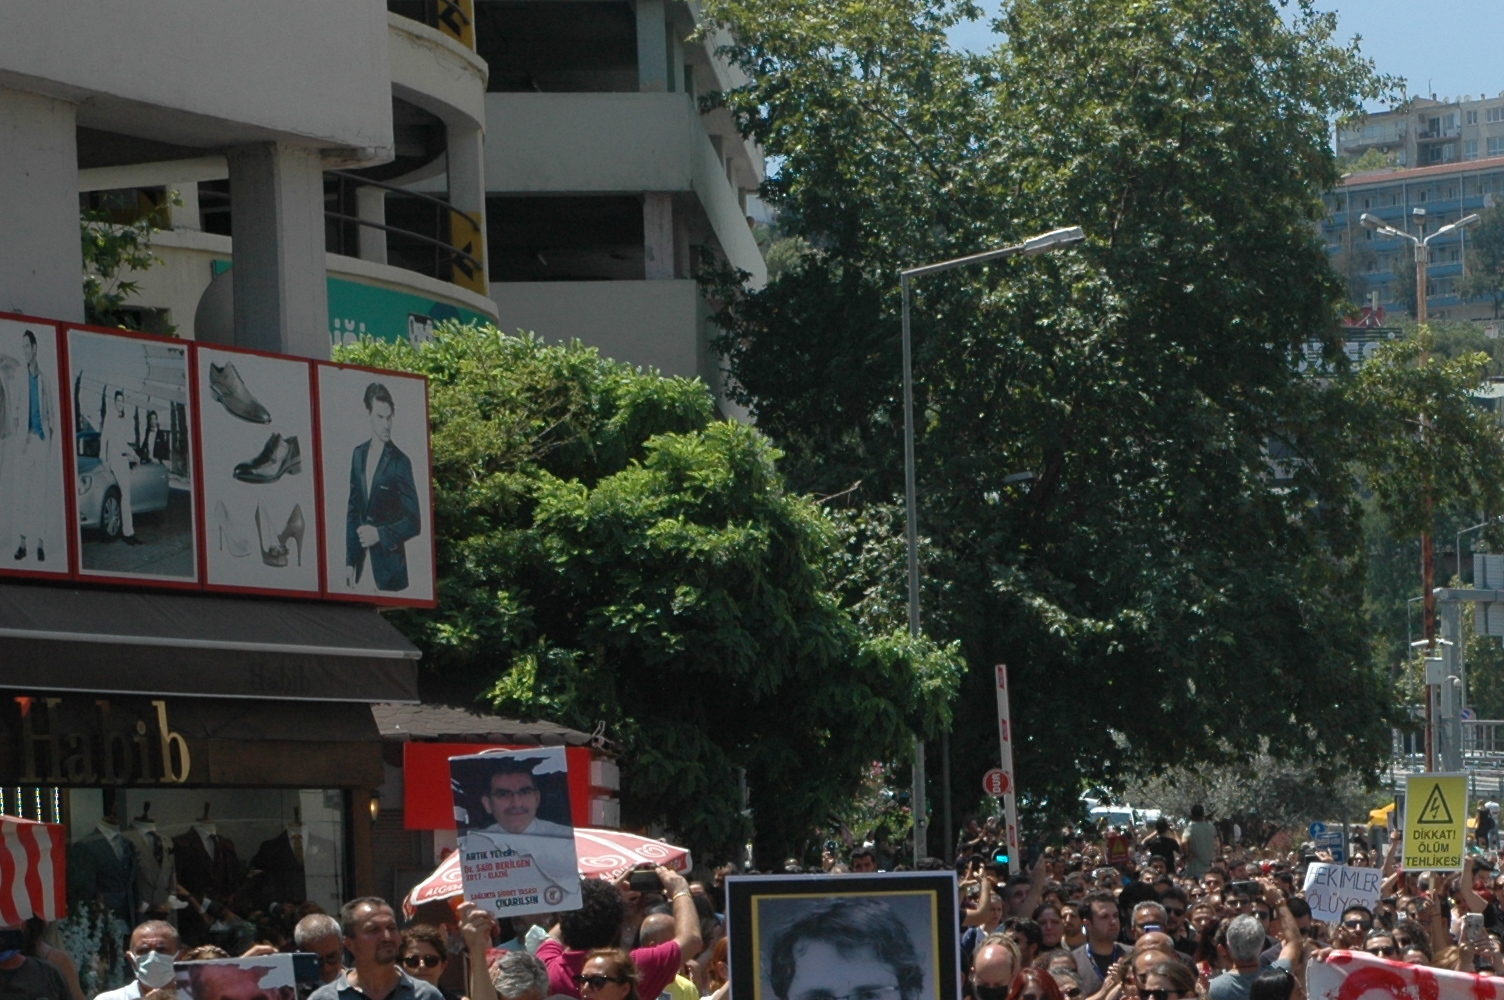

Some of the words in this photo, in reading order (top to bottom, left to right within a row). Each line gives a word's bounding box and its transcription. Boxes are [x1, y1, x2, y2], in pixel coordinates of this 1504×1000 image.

[14, 696, 191, 784] Habib
[992, 773, 1001, 793] DUR
[1412, 828, 1456, 840] DİKKAT!
[1418, 841, 1450, 853] ÖLÜM
[1405, 854, 1461, 867] TEHLİKESİ
